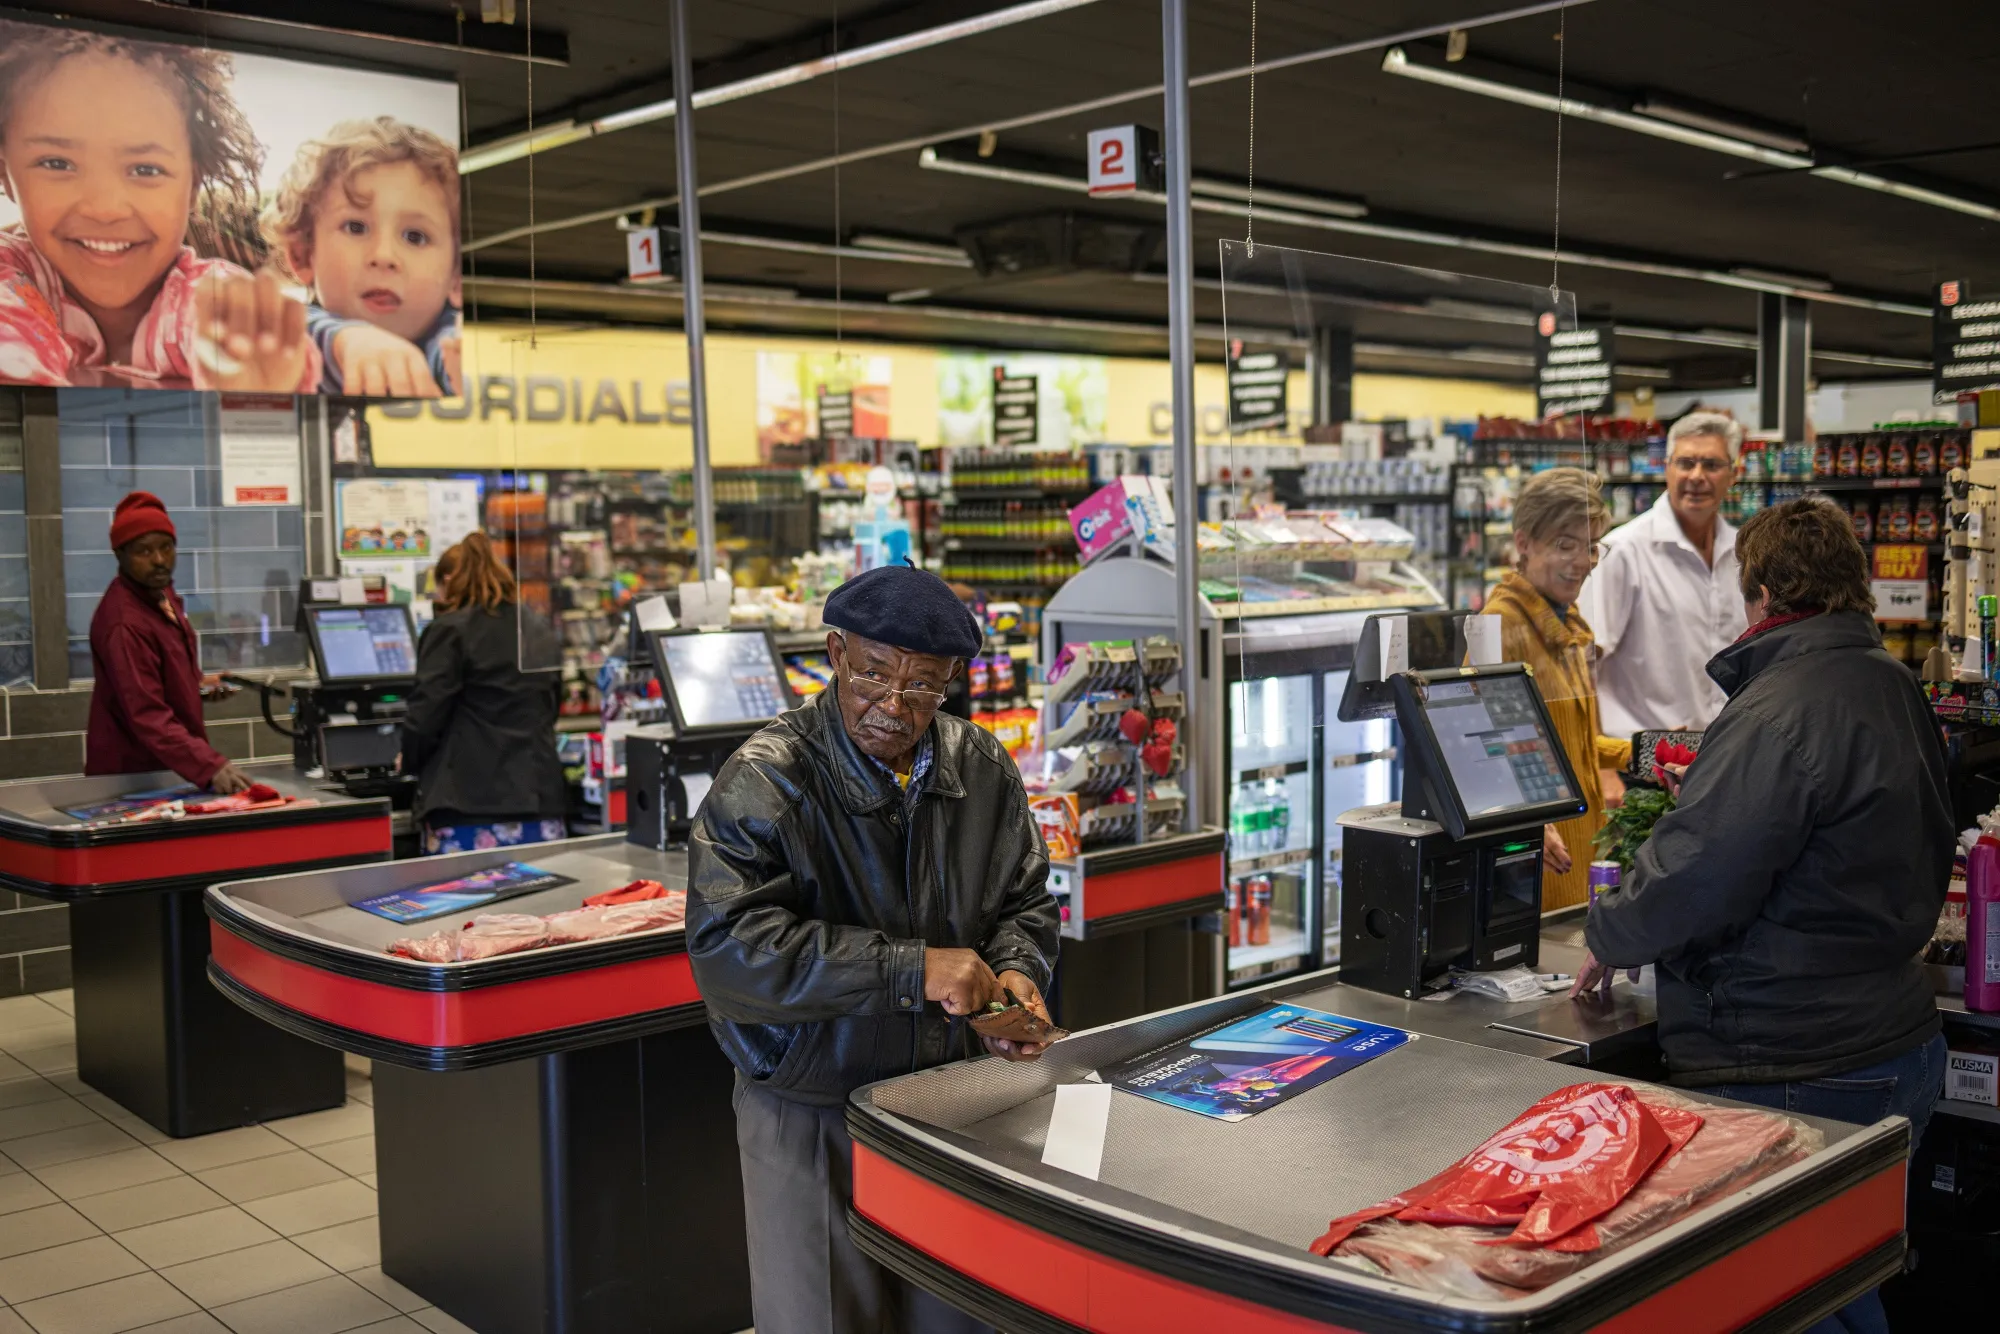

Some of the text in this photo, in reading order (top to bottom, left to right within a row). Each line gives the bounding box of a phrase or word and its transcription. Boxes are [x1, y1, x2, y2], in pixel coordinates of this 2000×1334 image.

[1100, 139, 1124, 176] 2
[638, 237, 653, 265] 1
[1941, 281, 1960, 306] 5
[1876, 547, 1924, 564] BEST
[1878, 563, 1918, 578] BUY
[1352, 1032, 1394, 1051] vuse
[1127, 1054, 1202, 1084] DISPOSABLES
[1952, 1058, 1992, 1073] AUSMA
[1137, 1067, 1187, 1087] VUSE GO
[1571, 1137, 1627, 1175] 100%
